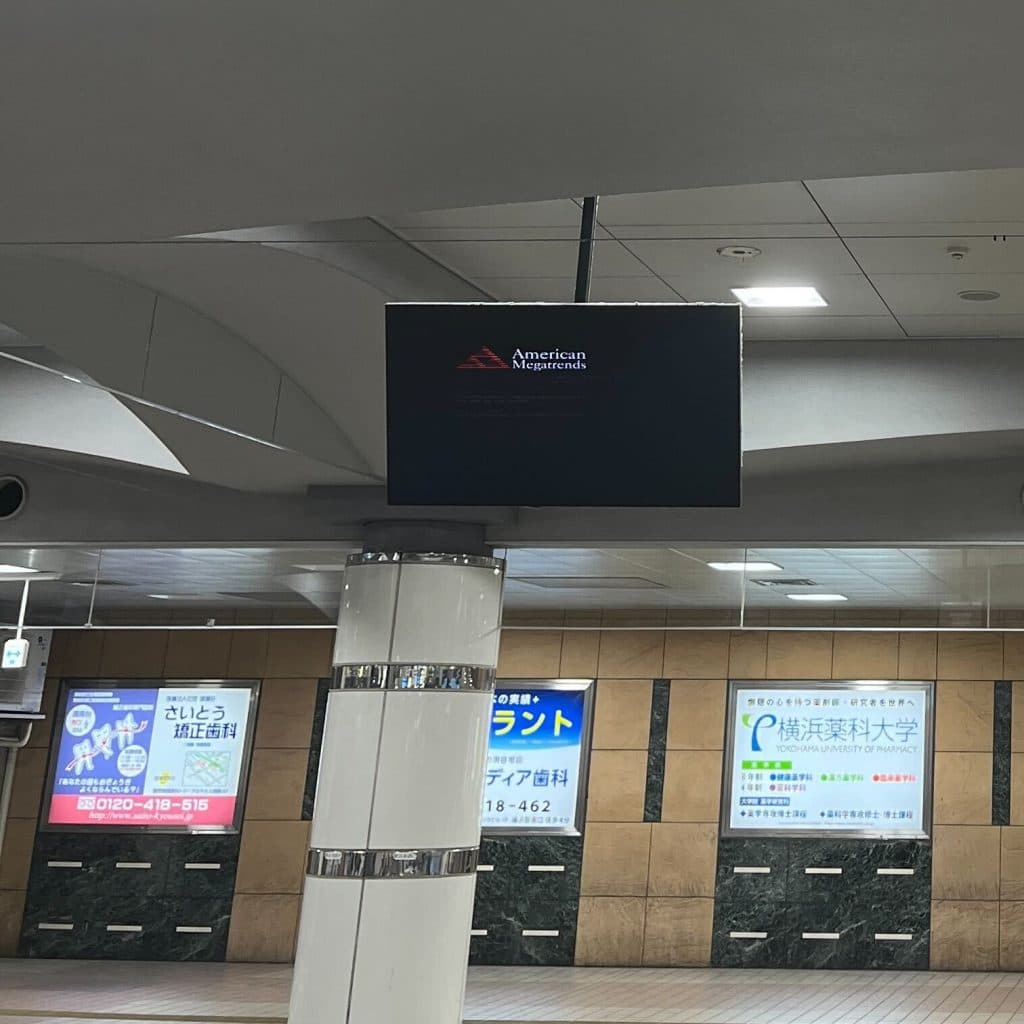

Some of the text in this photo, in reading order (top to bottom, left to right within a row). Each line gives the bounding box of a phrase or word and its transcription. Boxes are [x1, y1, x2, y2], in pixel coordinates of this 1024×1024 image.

[512, 348, 586, 360] American
[512, 360, 587, 371] Megatrends
[165, 705, 226, 721] さいとう
[174, 722, 237, 739] 矯正歯科
[493, 709, 573, 736] ラント
[777, 717, 918, 743] 横浜薬科大学
[776, 744, 918, 754] YOKOHAMA UNIVERSITY OF PHARMACY
[486, 769, 568, 787] ディア歯科
[486, 800, 551, 812] 18-462
